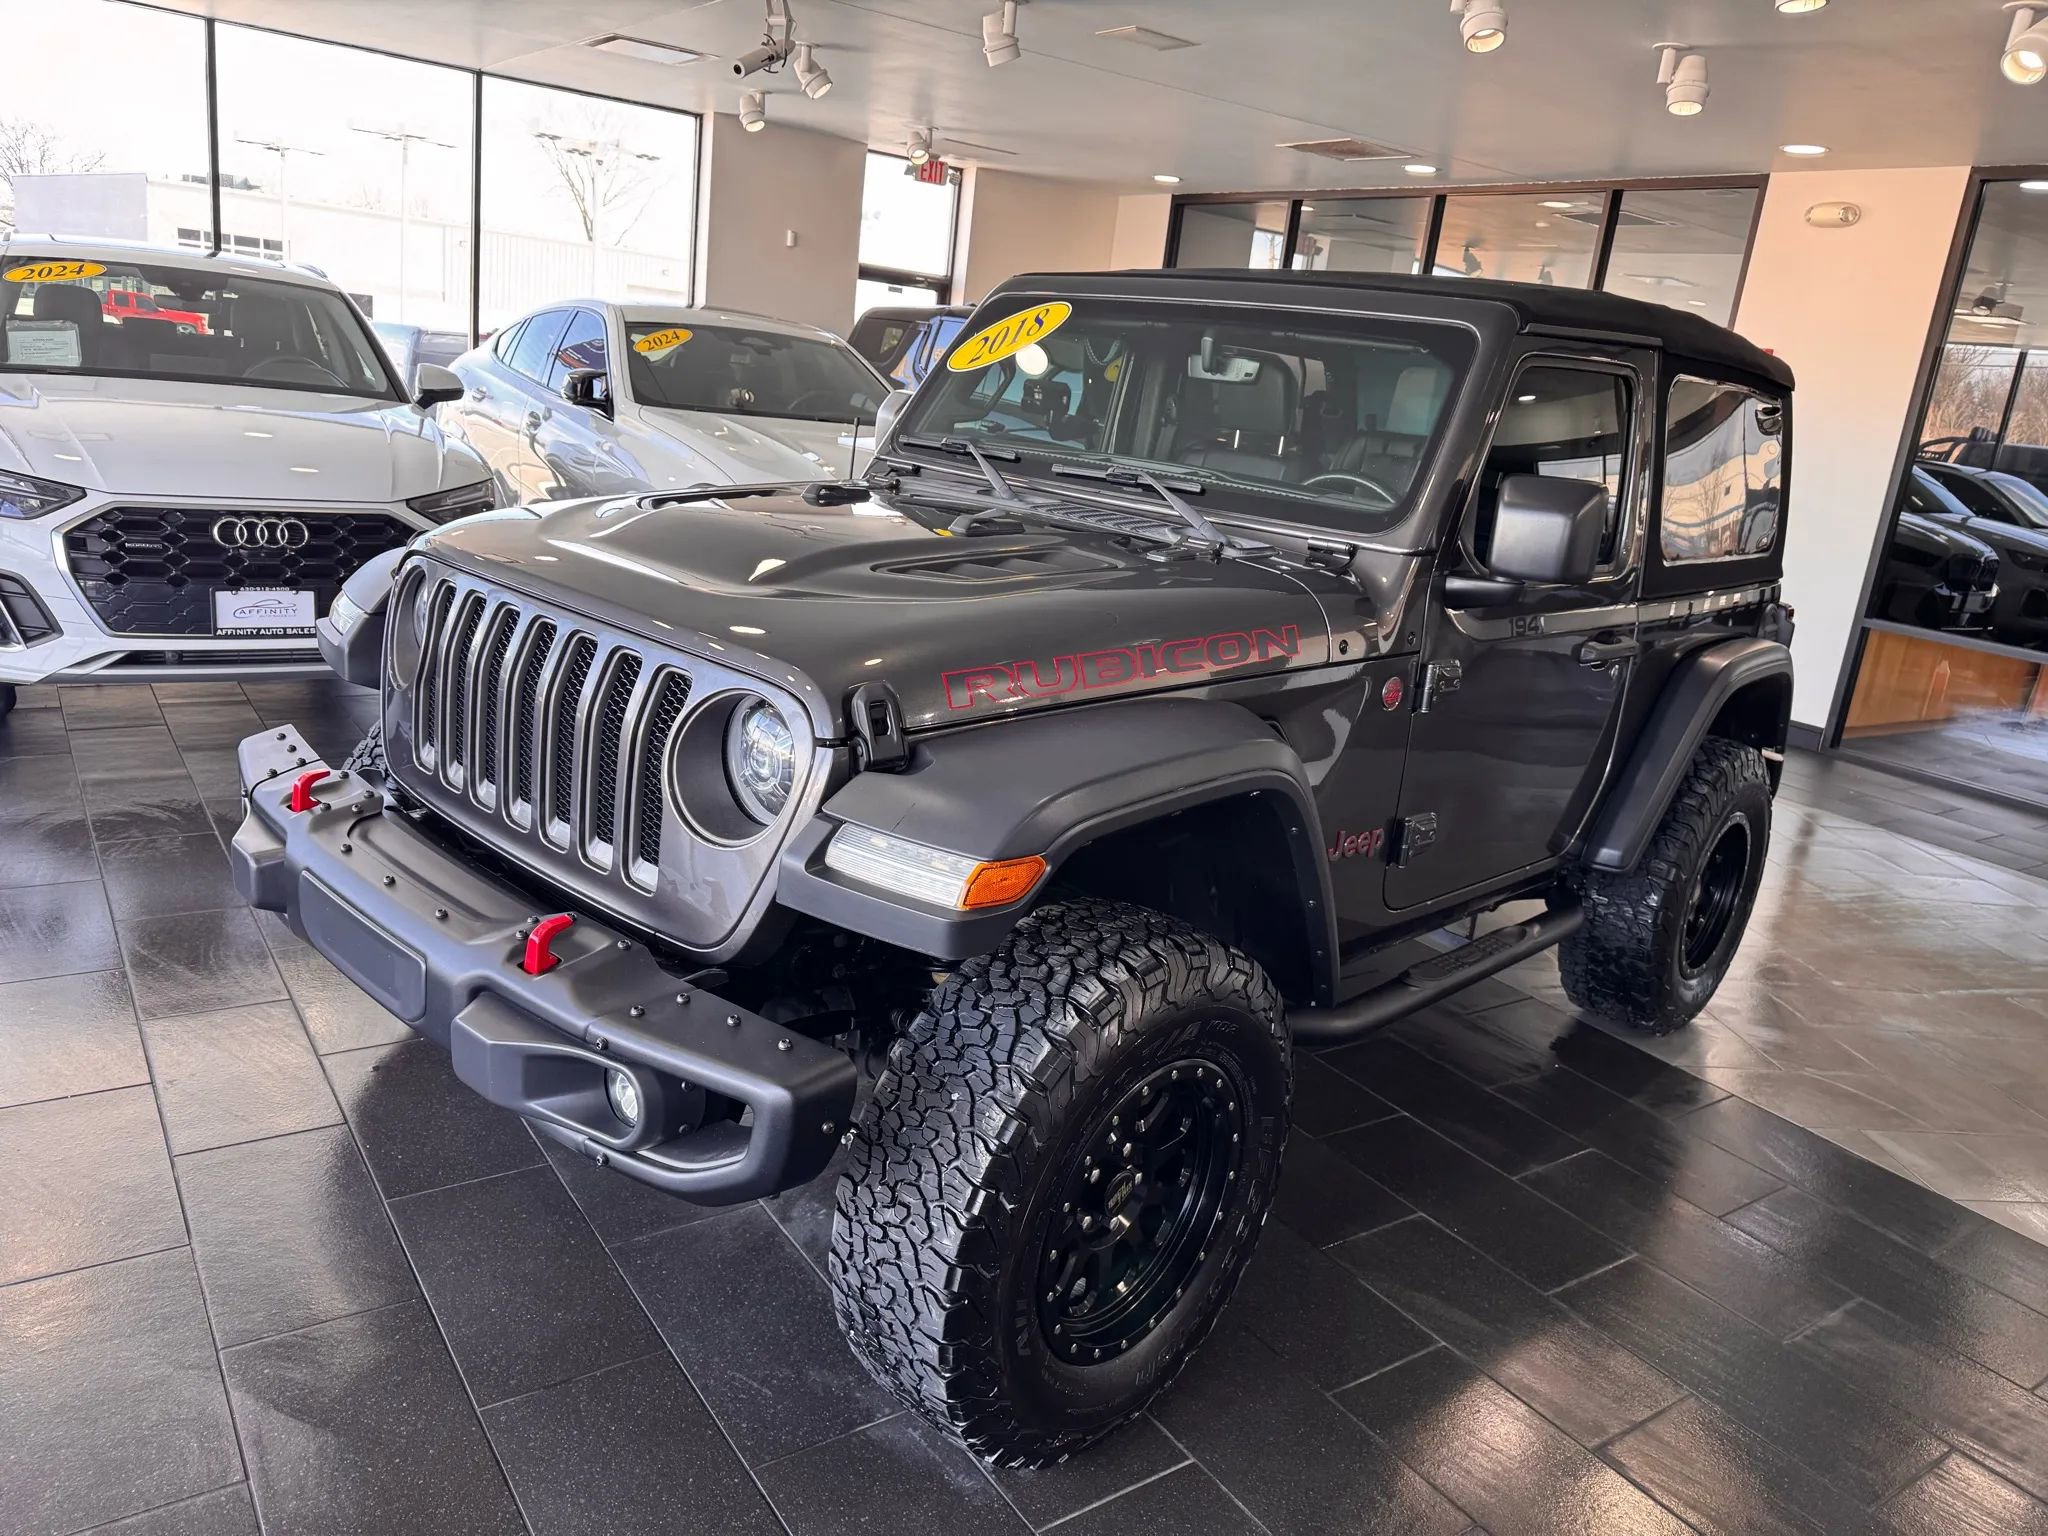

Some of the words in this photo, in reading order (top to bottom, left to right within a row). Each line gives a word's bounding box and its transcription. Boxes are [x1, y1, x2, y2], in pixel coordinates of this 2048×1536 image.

[920, 160, 945, 184] EXIT
[20, 263, 86, 280] 2024
[643, 330, 680, 350] 2024
[967, 308, 1050, 366] 2018
[216, 628, 257, 636] AFFINITY
[286, 627, 316, 635] SALES
[941, 624, 1301, 711] RUBICON
[1327, 827, 1385, 862] Jeep
